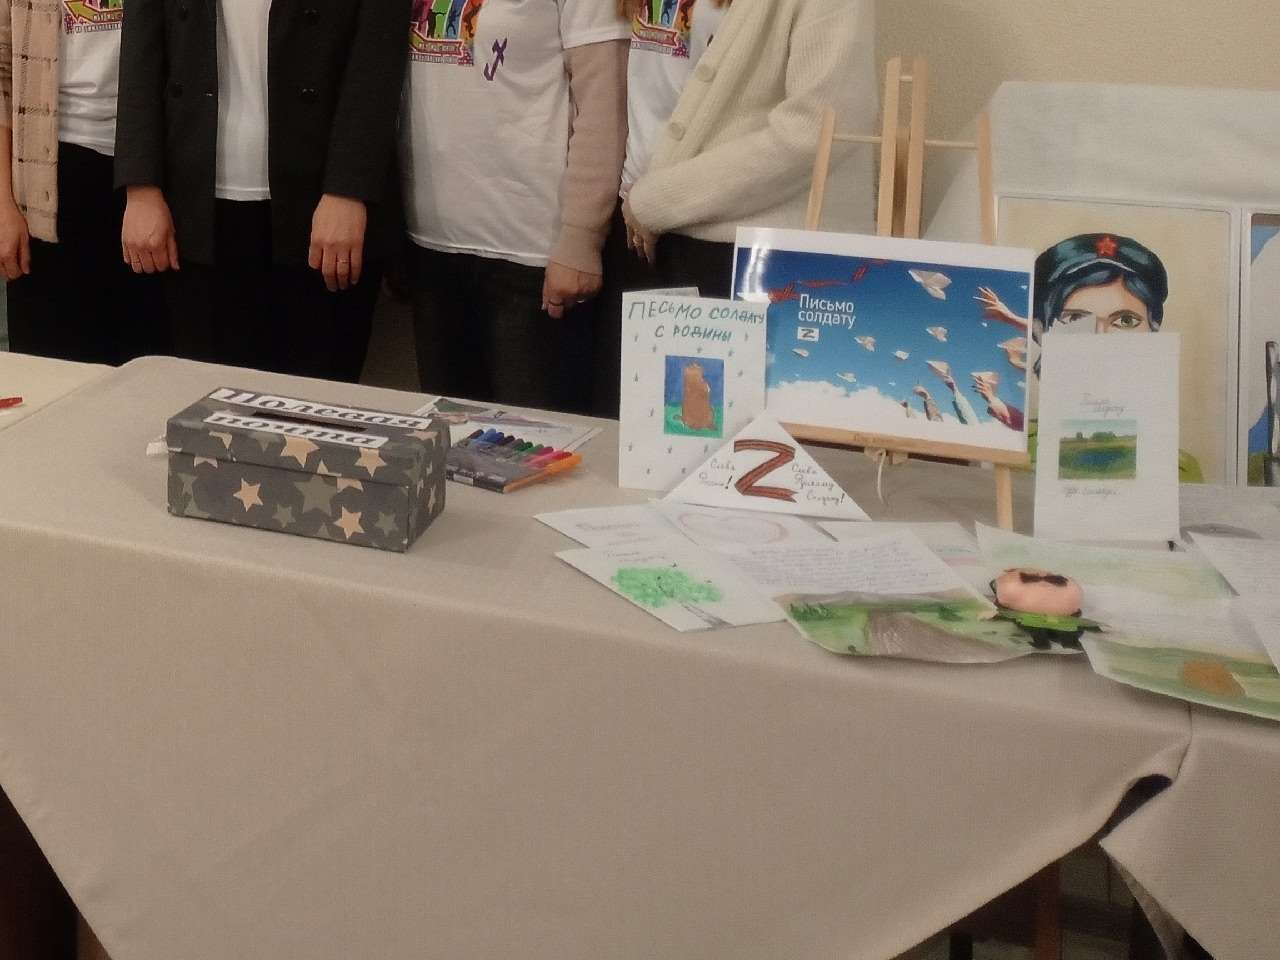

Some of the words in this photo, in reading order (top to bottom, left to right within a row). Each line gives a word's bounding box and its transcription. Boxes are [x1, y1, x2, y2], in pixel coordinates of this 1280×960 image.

[799, 293, 854, 313] Письмо
[709, 307, 764, 324] СОЛДАТУ
[798, 310, 856, 329] солдату
[655, 326, 665, 338] С
[673, 325, 731, 341] РОДИНЫ
[801, 328, 815, 338] Z
[220, 391, 422, 427] Полевая
[212, 416, 376, 445] почта
[734, 439, 799, 503] Z
